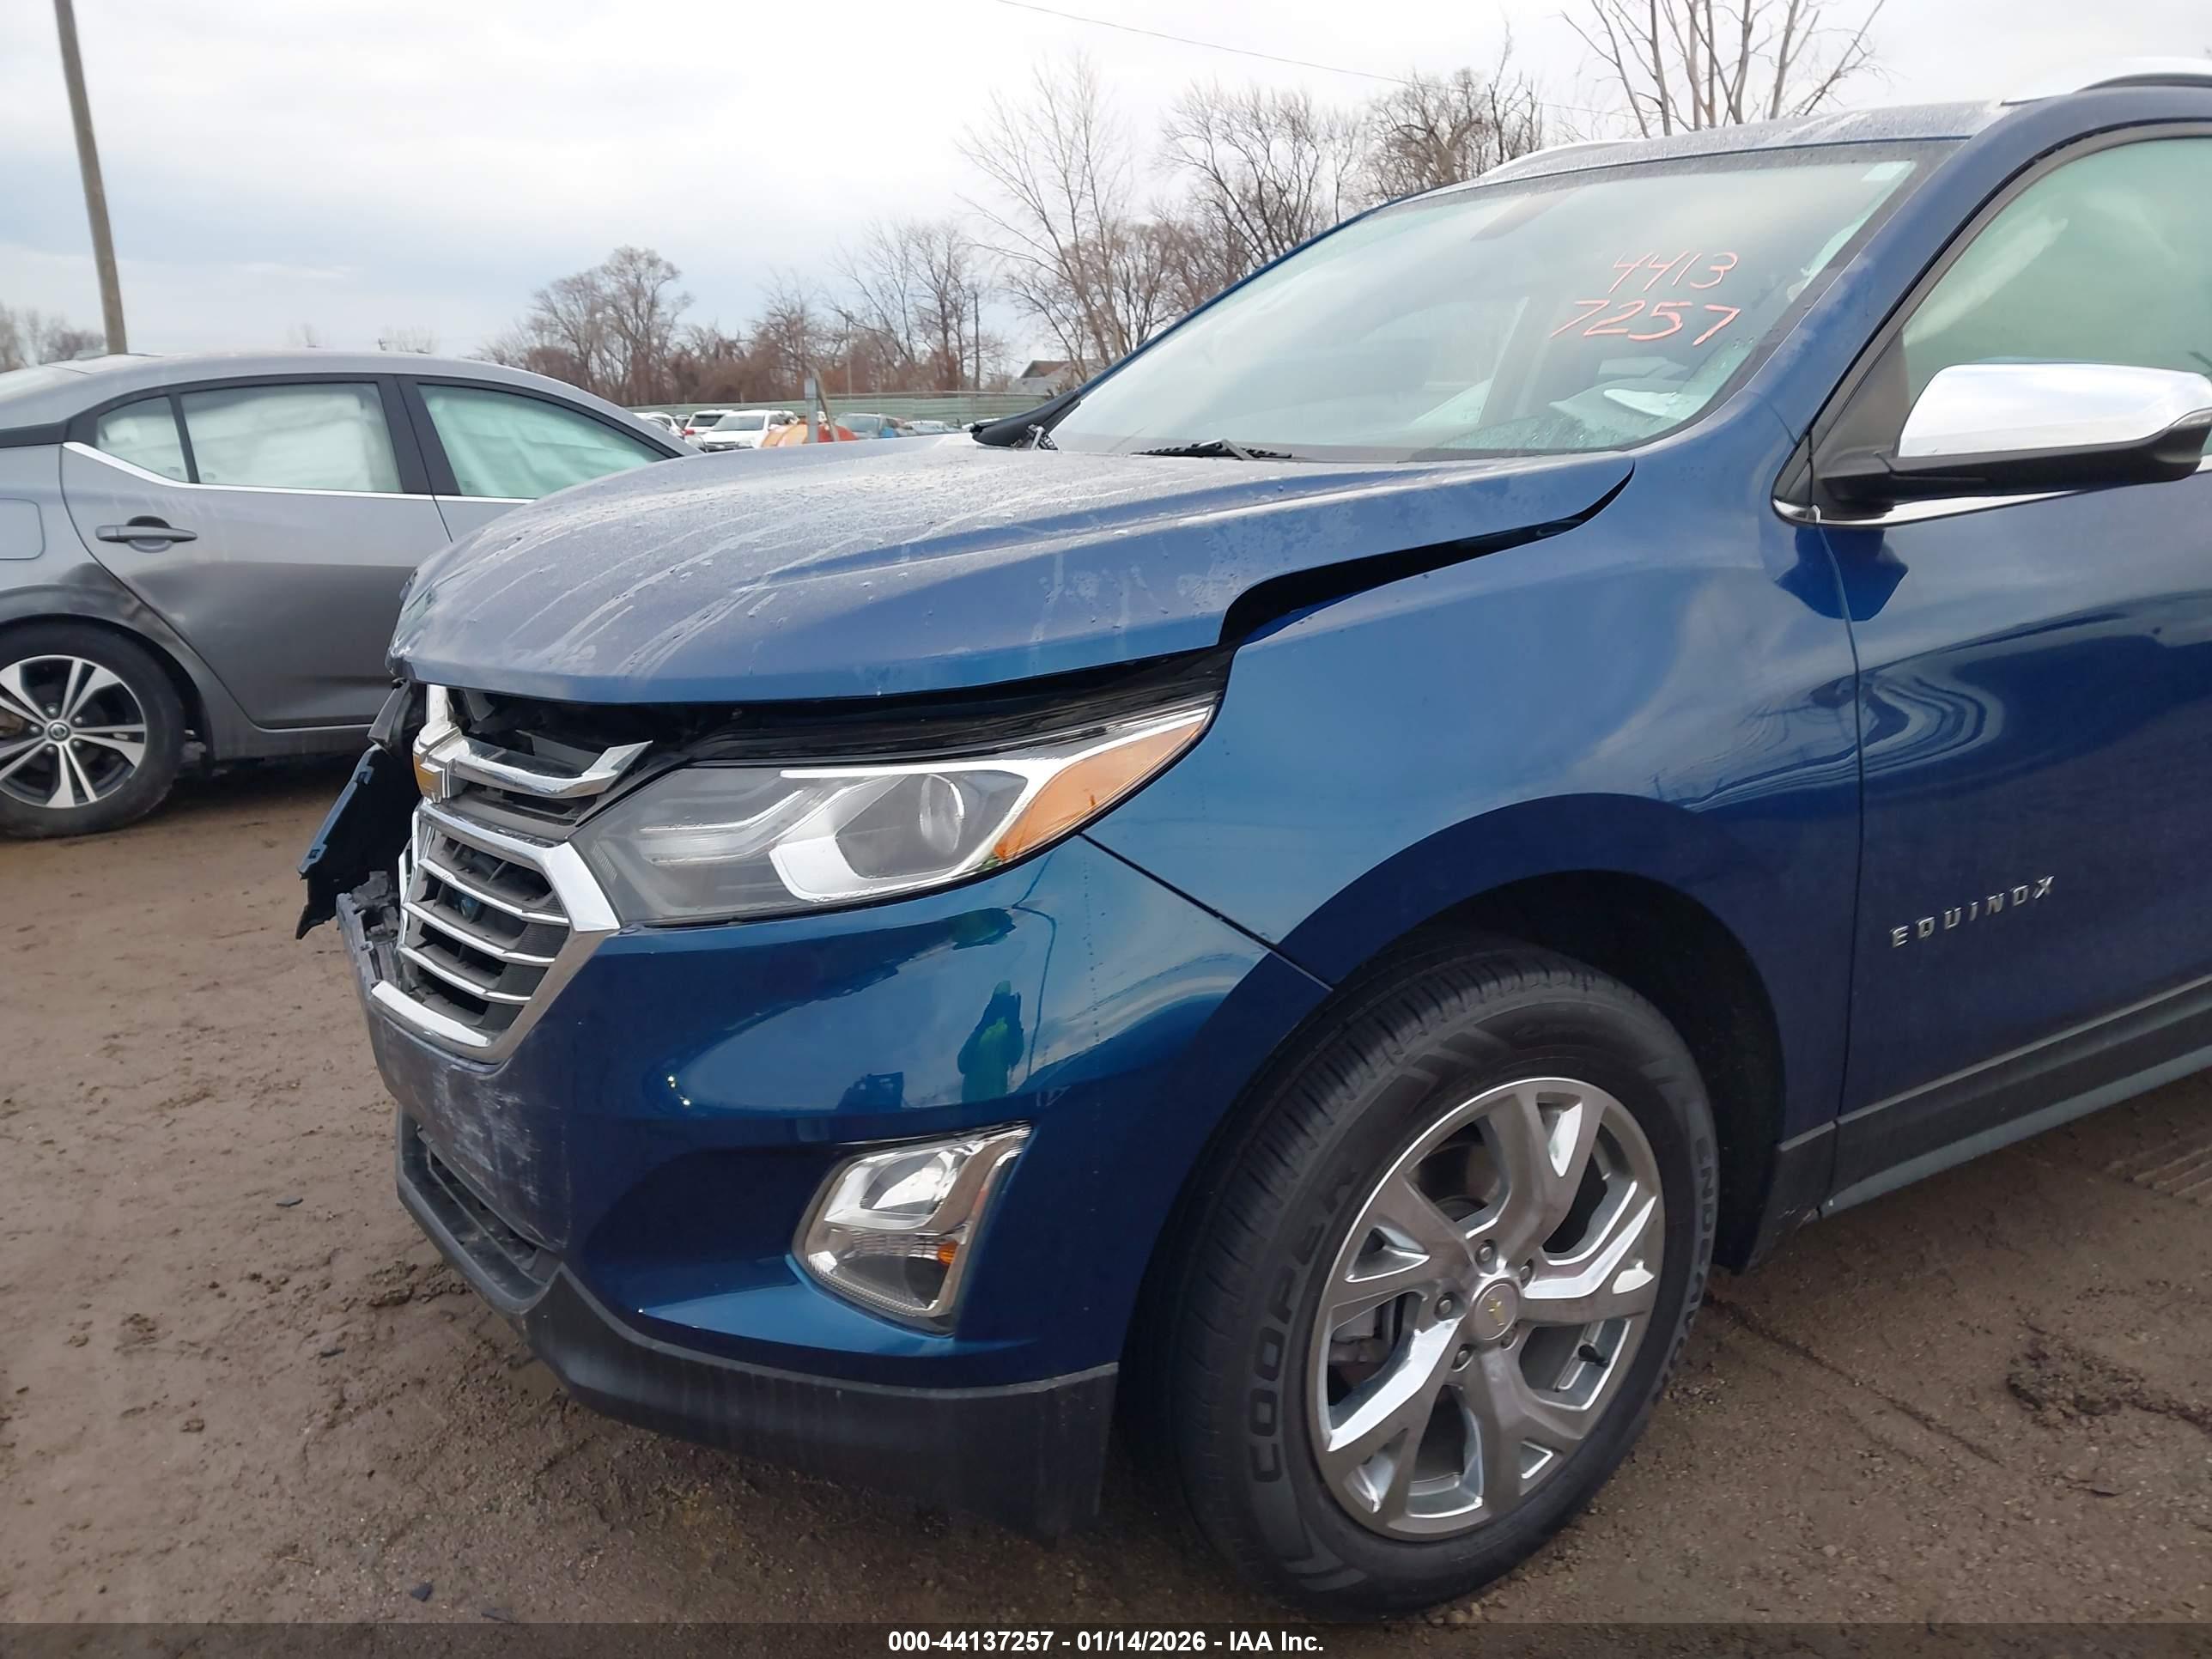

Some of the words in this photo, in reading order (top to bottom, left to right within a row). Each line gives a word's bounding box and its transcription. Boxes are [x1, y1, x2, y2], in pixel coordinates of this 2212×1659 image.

[1607, 251, 1739, 294] 4413
[1549, 299, 1741, 347] 7257
[1890, 875, 2055, 948] EQUINOX
